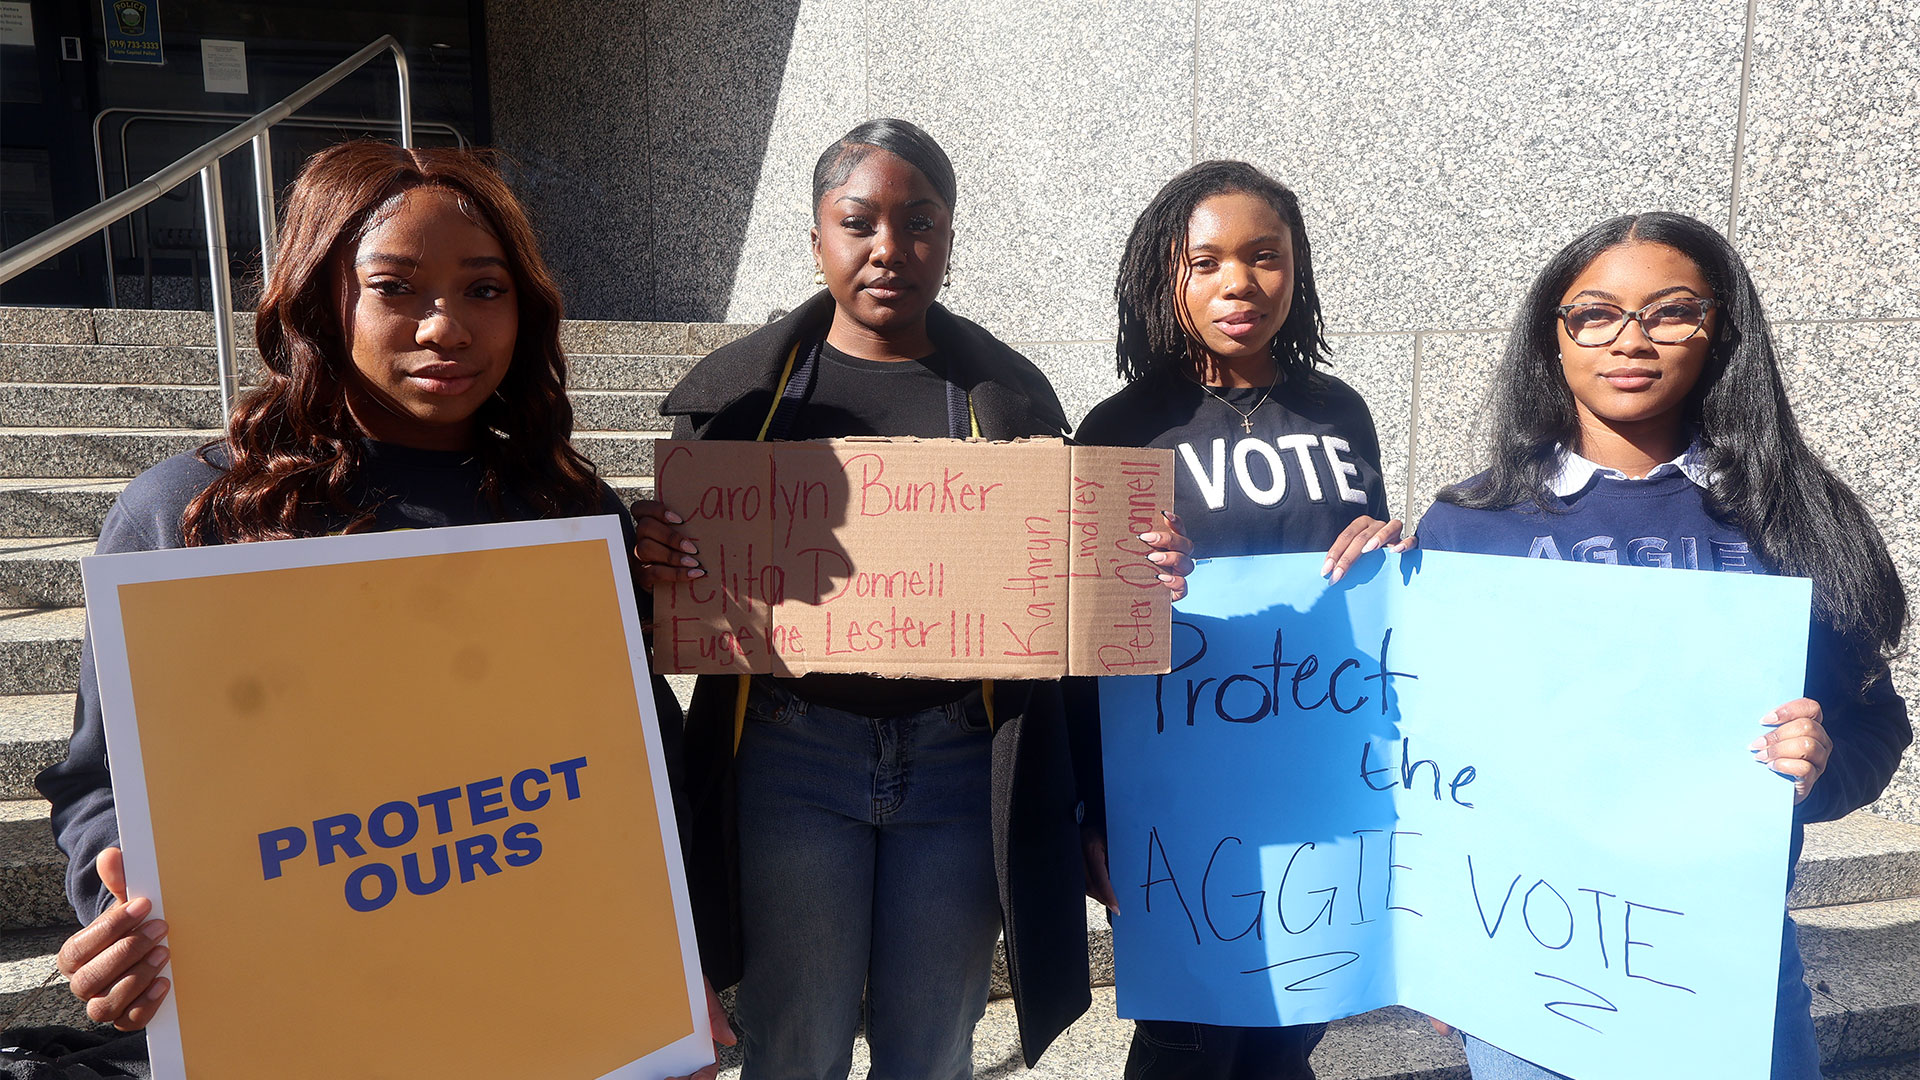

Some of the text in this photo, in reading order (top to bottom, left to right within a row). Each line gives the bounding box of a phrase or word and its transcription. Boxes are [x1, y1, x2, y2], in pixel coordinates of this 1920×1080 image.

[109, 40, 159, 49] (919) 733-3333
[115, 2, 145, 11] POLICE
[658, 446, 1003, 548] Carolyn Bunker
[1177, 434, 1367, 510] VOTE
[1053, 476, 1105, 578] Lindley
[1527, 535, 1753, 574] AGGIE
[797, 548, 944, 606] Donnell
[1003, 516, 1069, 656] Kathryn
[671, 615, 806, 673] Eugene
[825, 606, 942, 656] Lester
[1097, 599, 1159, 672] Peter
[1156, 621, 1419, 734] Protect
[1359, 737, 1477, 809] the
[257, 756, 588, 881] PROTECT
[344, 822, 543, 912] OURS
[1139, 826, 1697, 994] AGGIE VOTE
